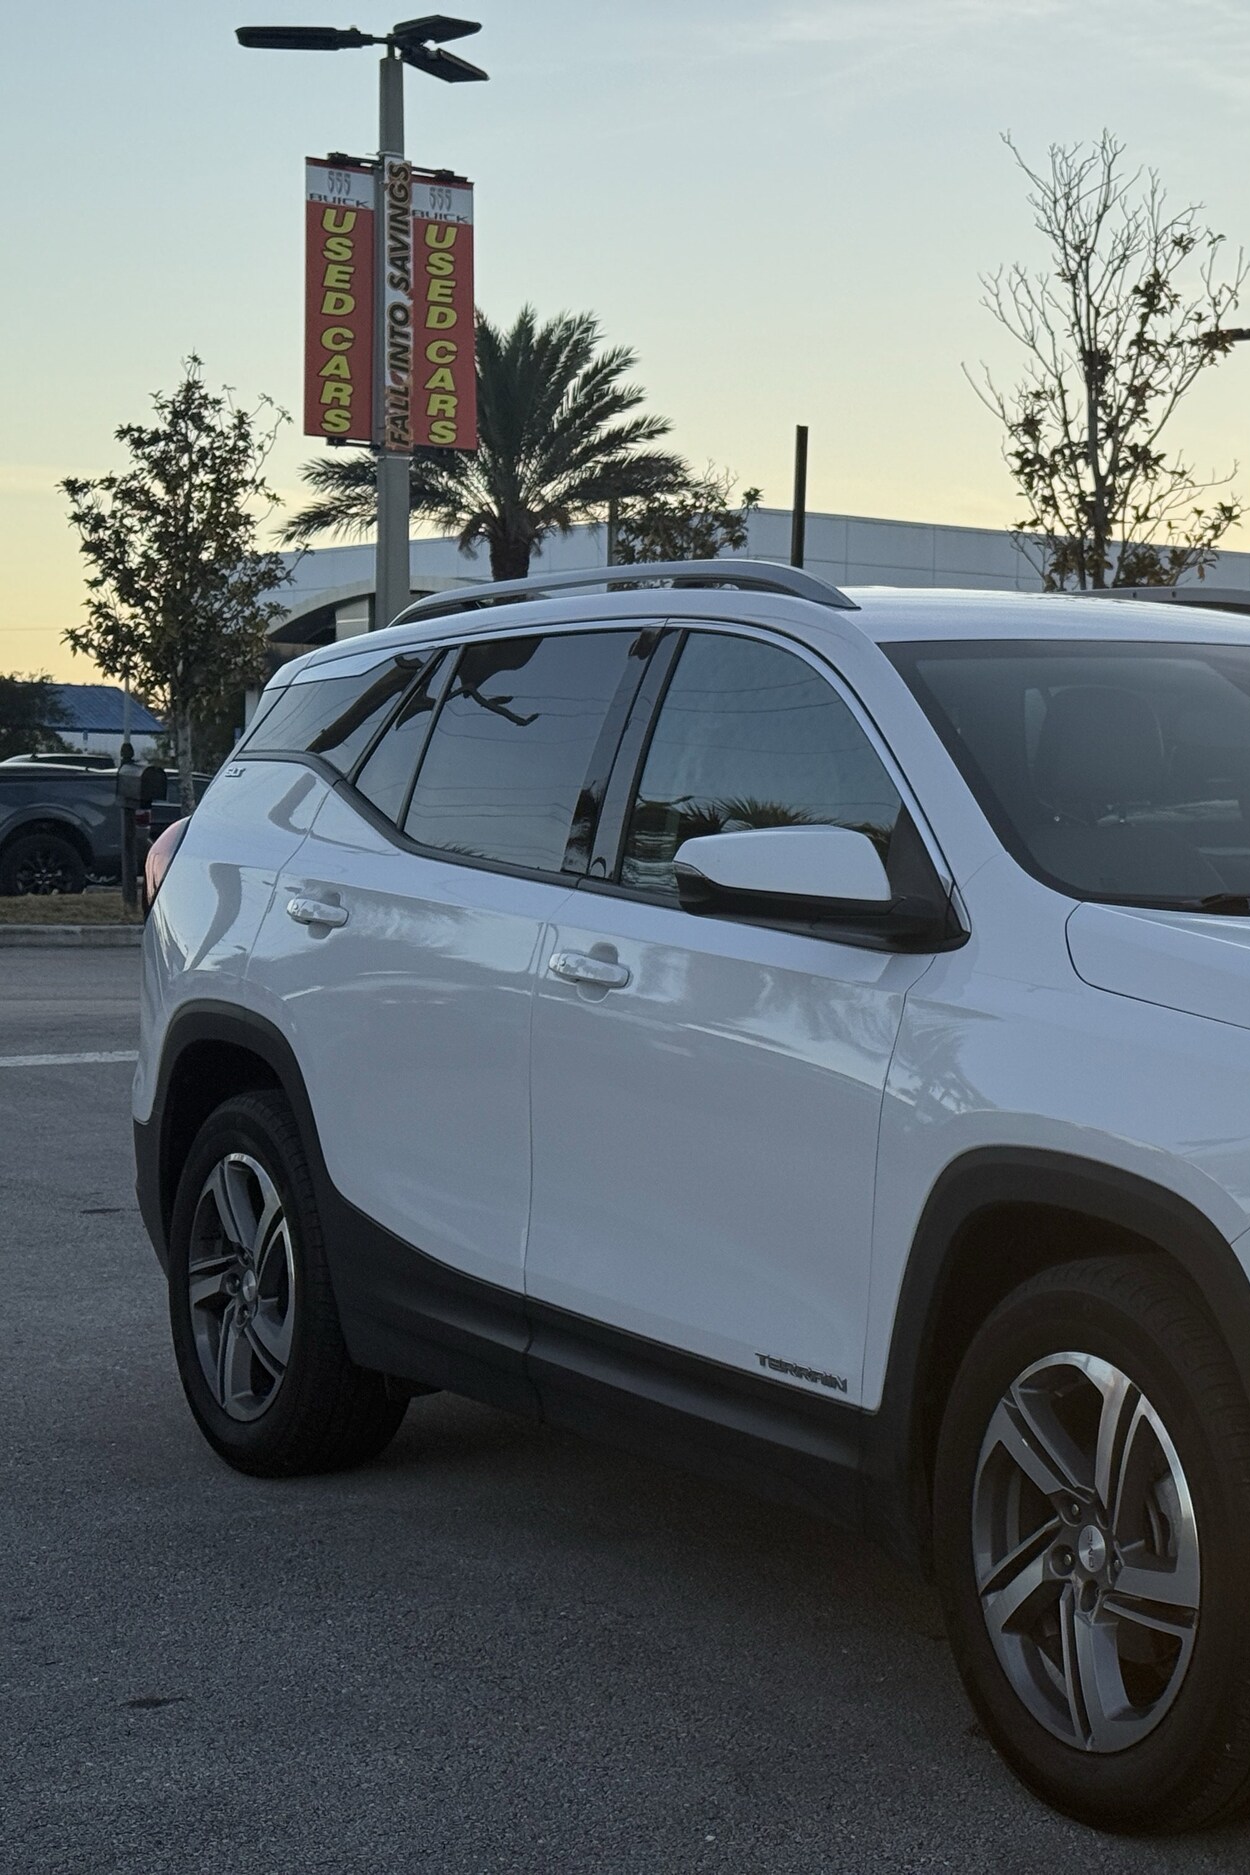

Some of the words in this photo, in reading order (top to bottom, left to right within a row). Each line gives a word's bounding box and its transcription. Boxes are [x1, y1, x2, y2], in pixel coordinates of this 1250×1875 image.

[321, 208, 357, 316] USED
[388, 162, 410, 293] SAVINGS
[424, 223, 457, 330] USED
[317, 326, 355, 433] CARS
[388, 303, 410, 374] INTO
[388, 386, 410, 447] FALL
[424, 340, 458, 445] CARS
[755, 1352, 848, 1394] TERRAIN
